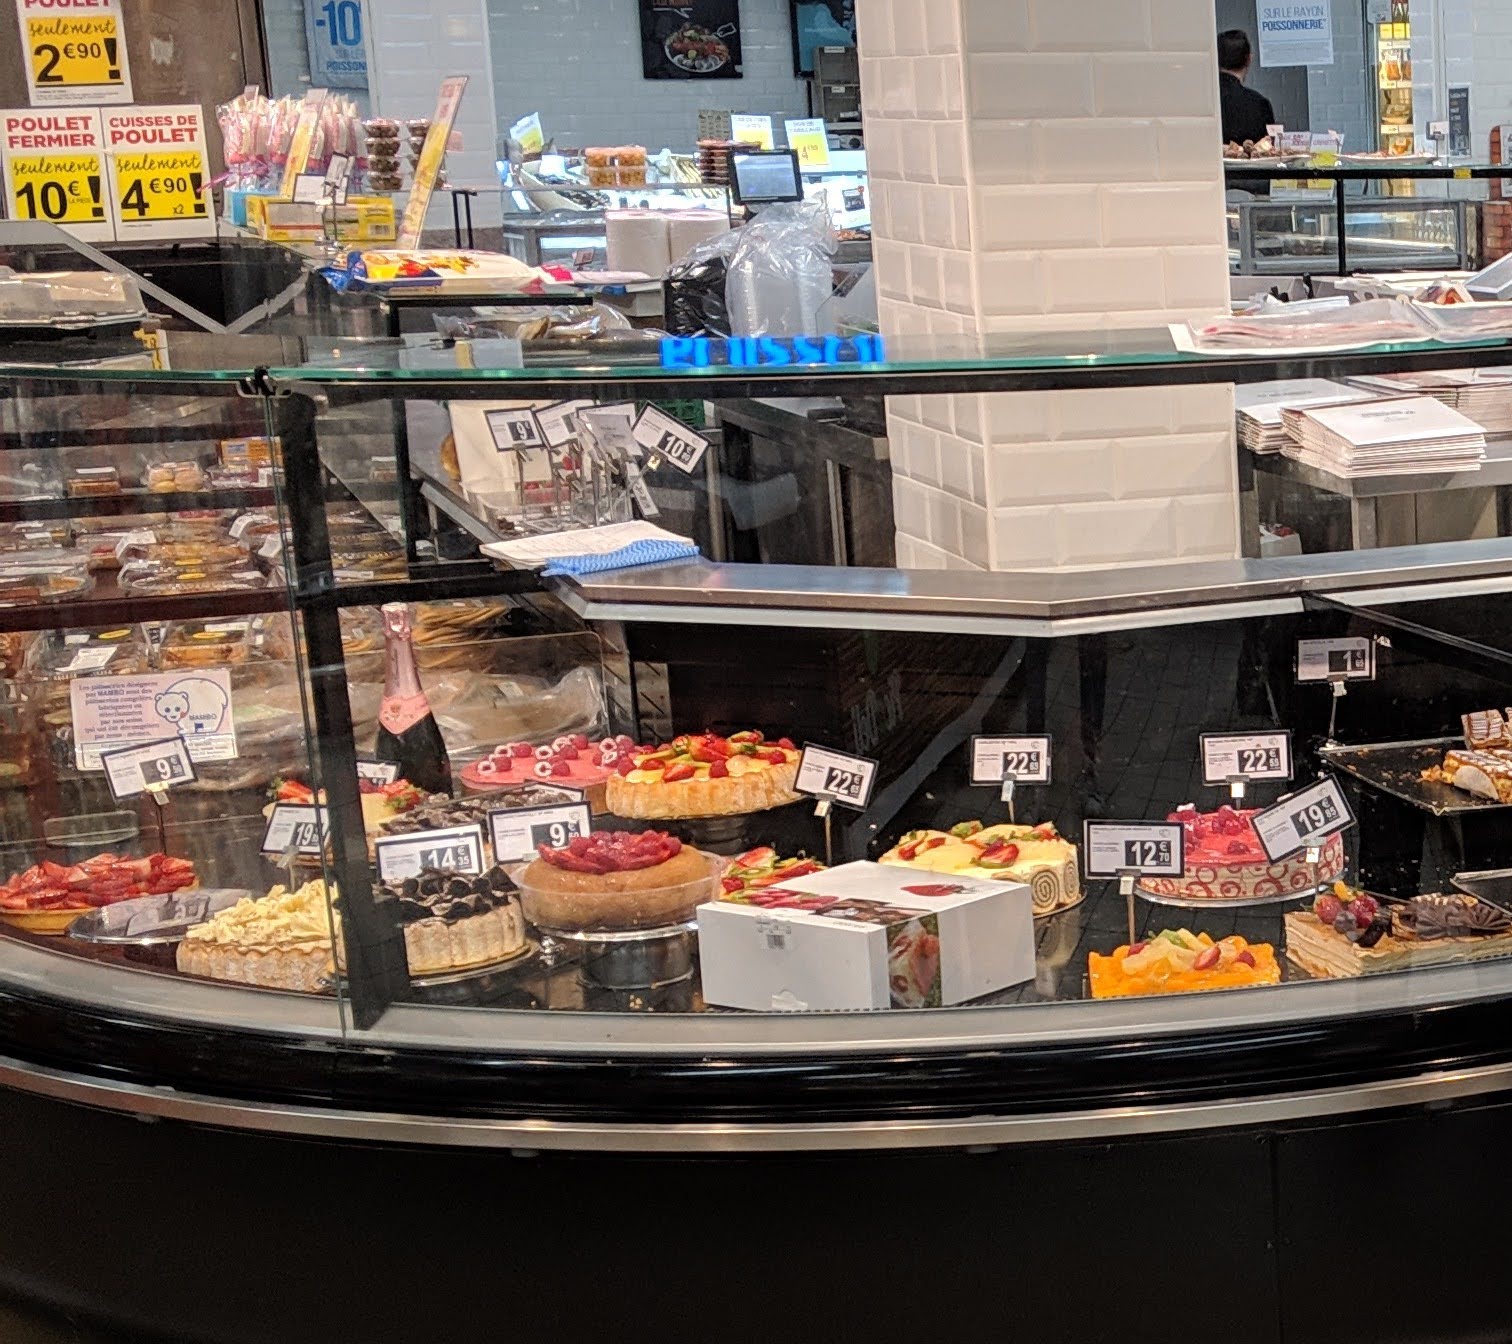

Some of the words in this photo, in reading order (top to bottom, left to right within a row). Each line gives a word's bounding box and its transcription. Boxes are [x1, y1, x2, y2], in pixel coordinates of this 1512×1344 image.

[29, 18, 116, 38] seulement
[6, 116, 93, 132] POULET
[109, 116, 173, 128] CUISSES
[177, 115, 198, 126] DE
[8, 133, 96, 149] FERMIER
[110, 128, 198, 145] POULET
[13, 157, 100, 176] seulement
[117, 154, 201, 173] seulement
